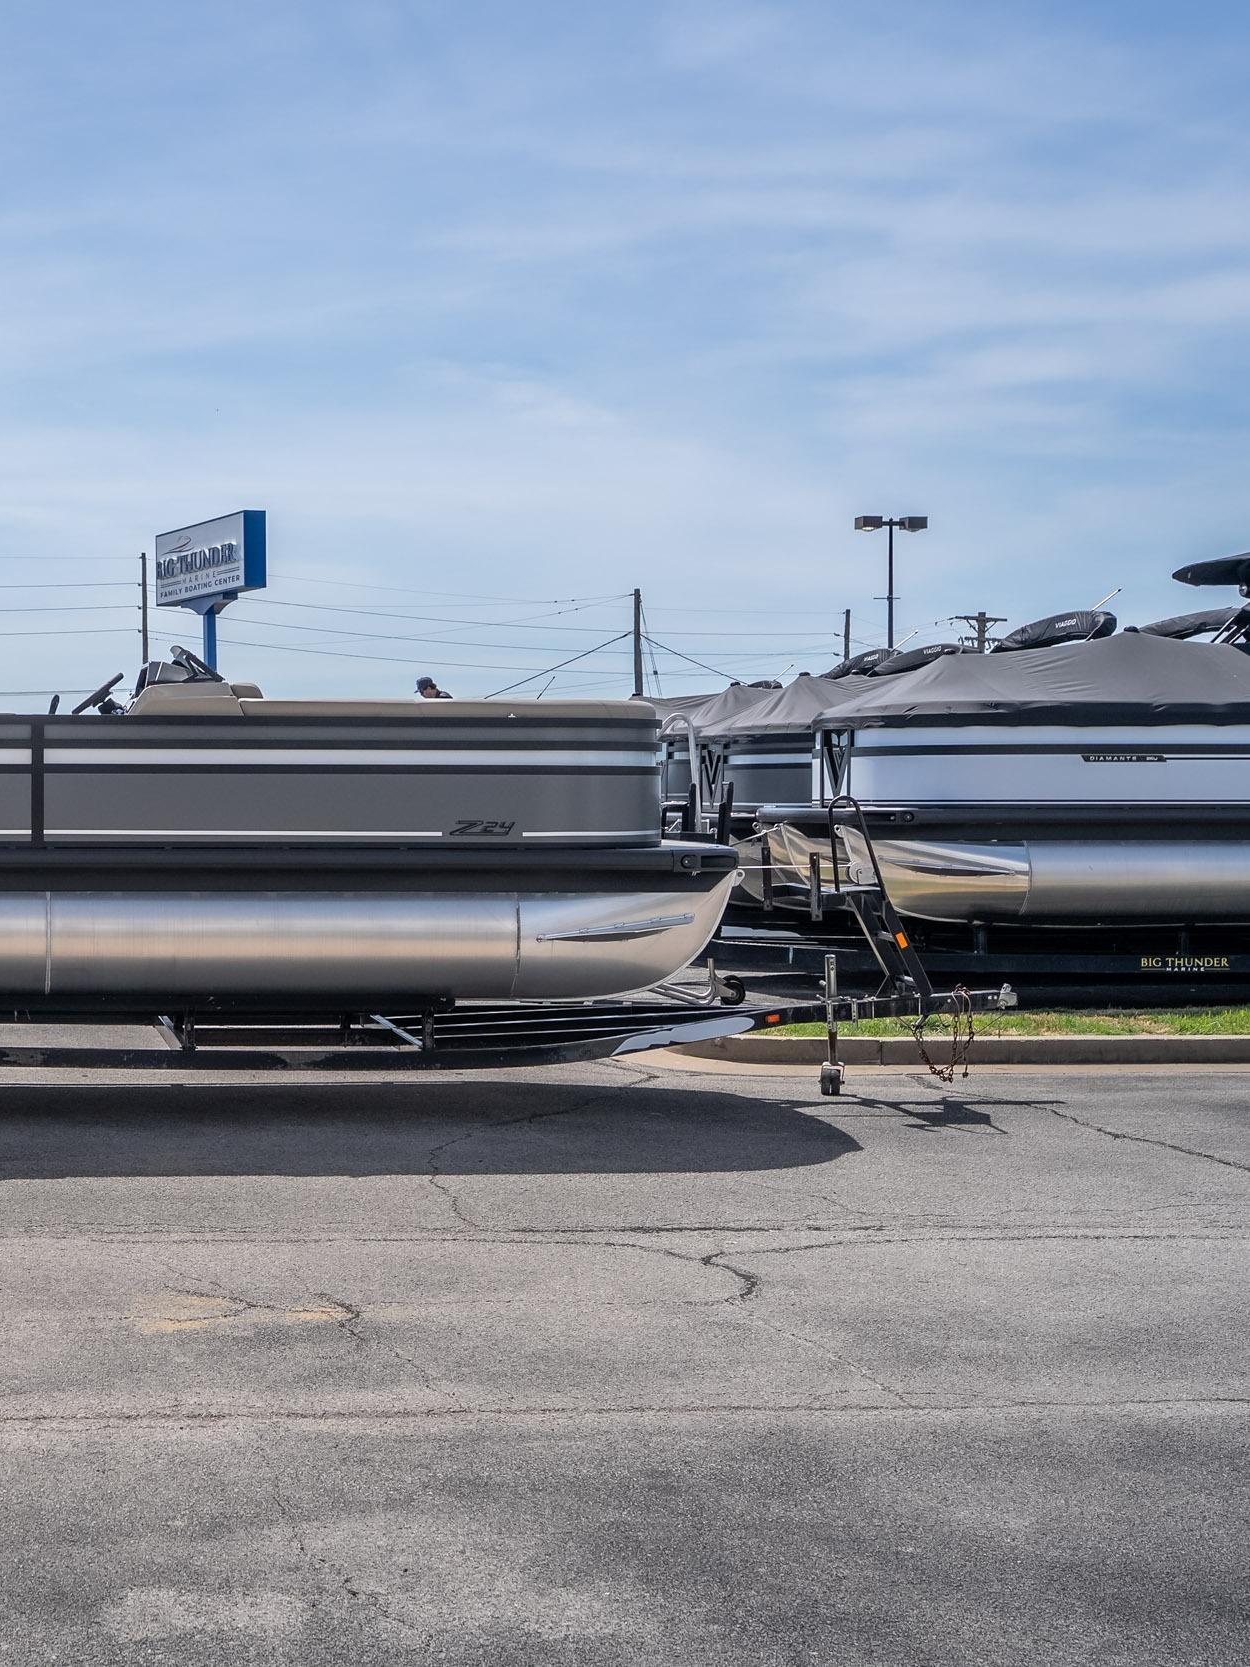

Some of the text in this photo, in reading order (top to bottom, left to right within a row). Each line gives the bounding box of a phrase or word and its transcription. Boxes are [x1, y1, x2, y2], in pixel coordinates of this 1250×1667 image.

[176, 542, 237, 575] THUNDER
[183, 571, 216, 584] MARINE
[160, 574, 241, 599] FAMILY BOATING CENTER
[449, 820, 516, 836] Z24
[1141, 957, 1229, 967] BIG THUNDER
